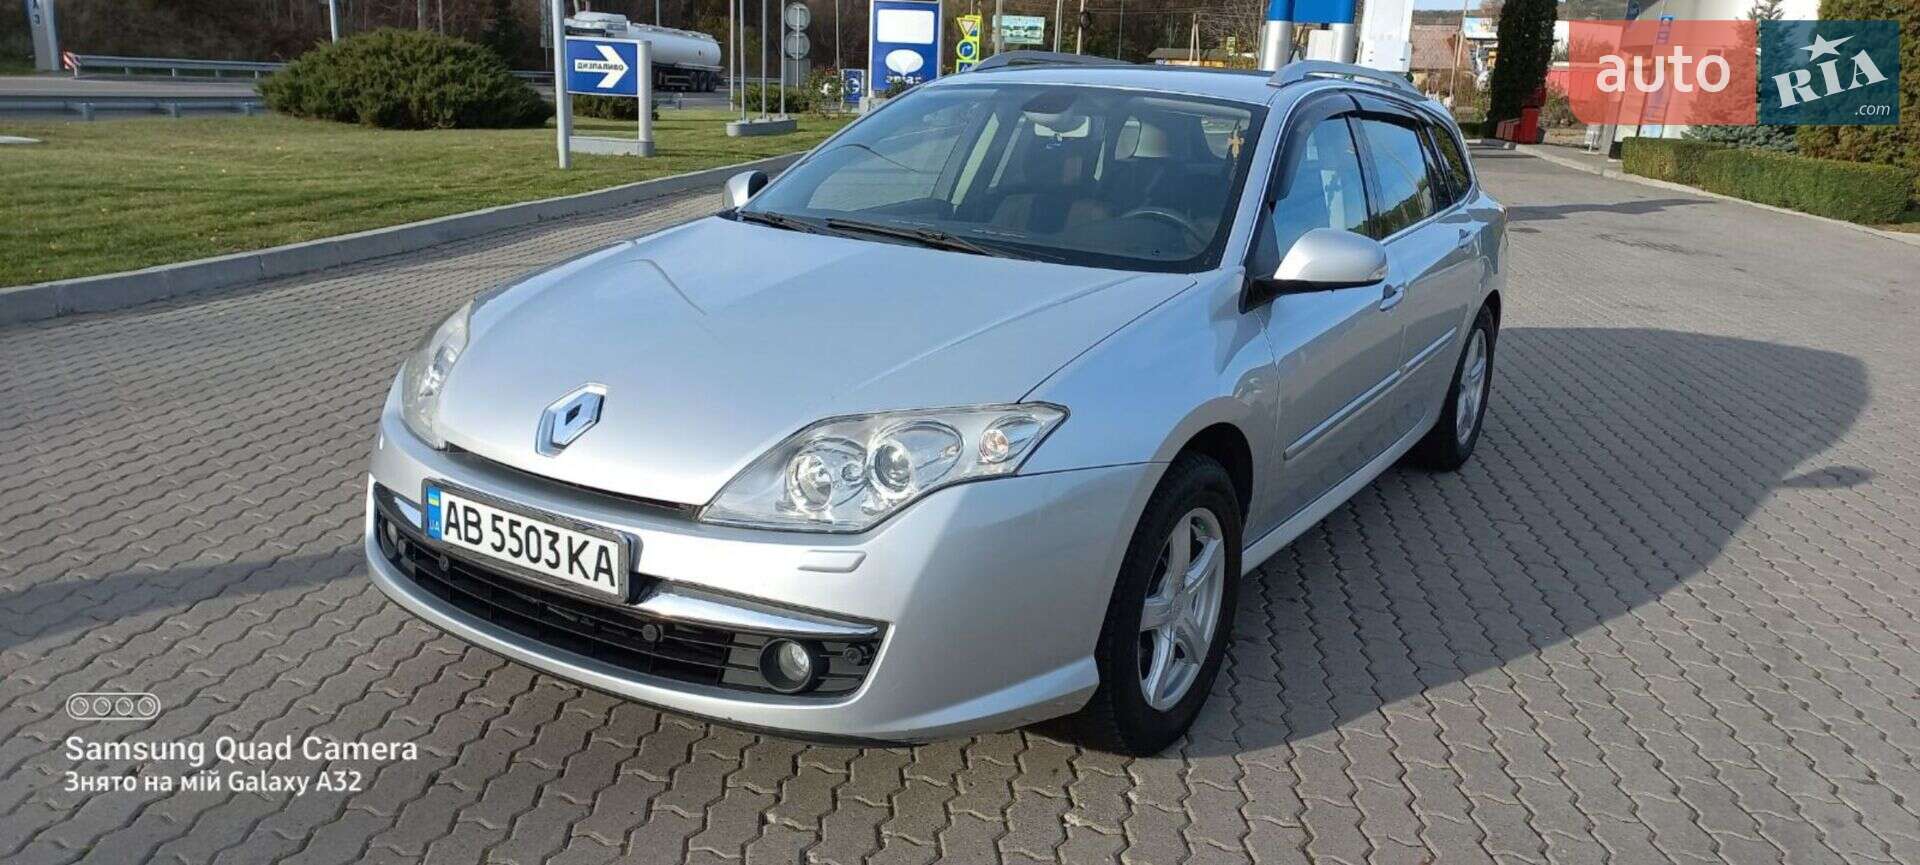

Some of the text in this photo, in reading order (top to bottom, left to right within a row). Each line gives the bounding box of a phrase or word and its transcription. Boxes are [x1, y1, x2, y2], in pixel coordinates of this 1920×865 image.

[577, 62, 624, 71] ДИЗПАЛИВО
[444, 500, 616, 587] AB 5503 KA
